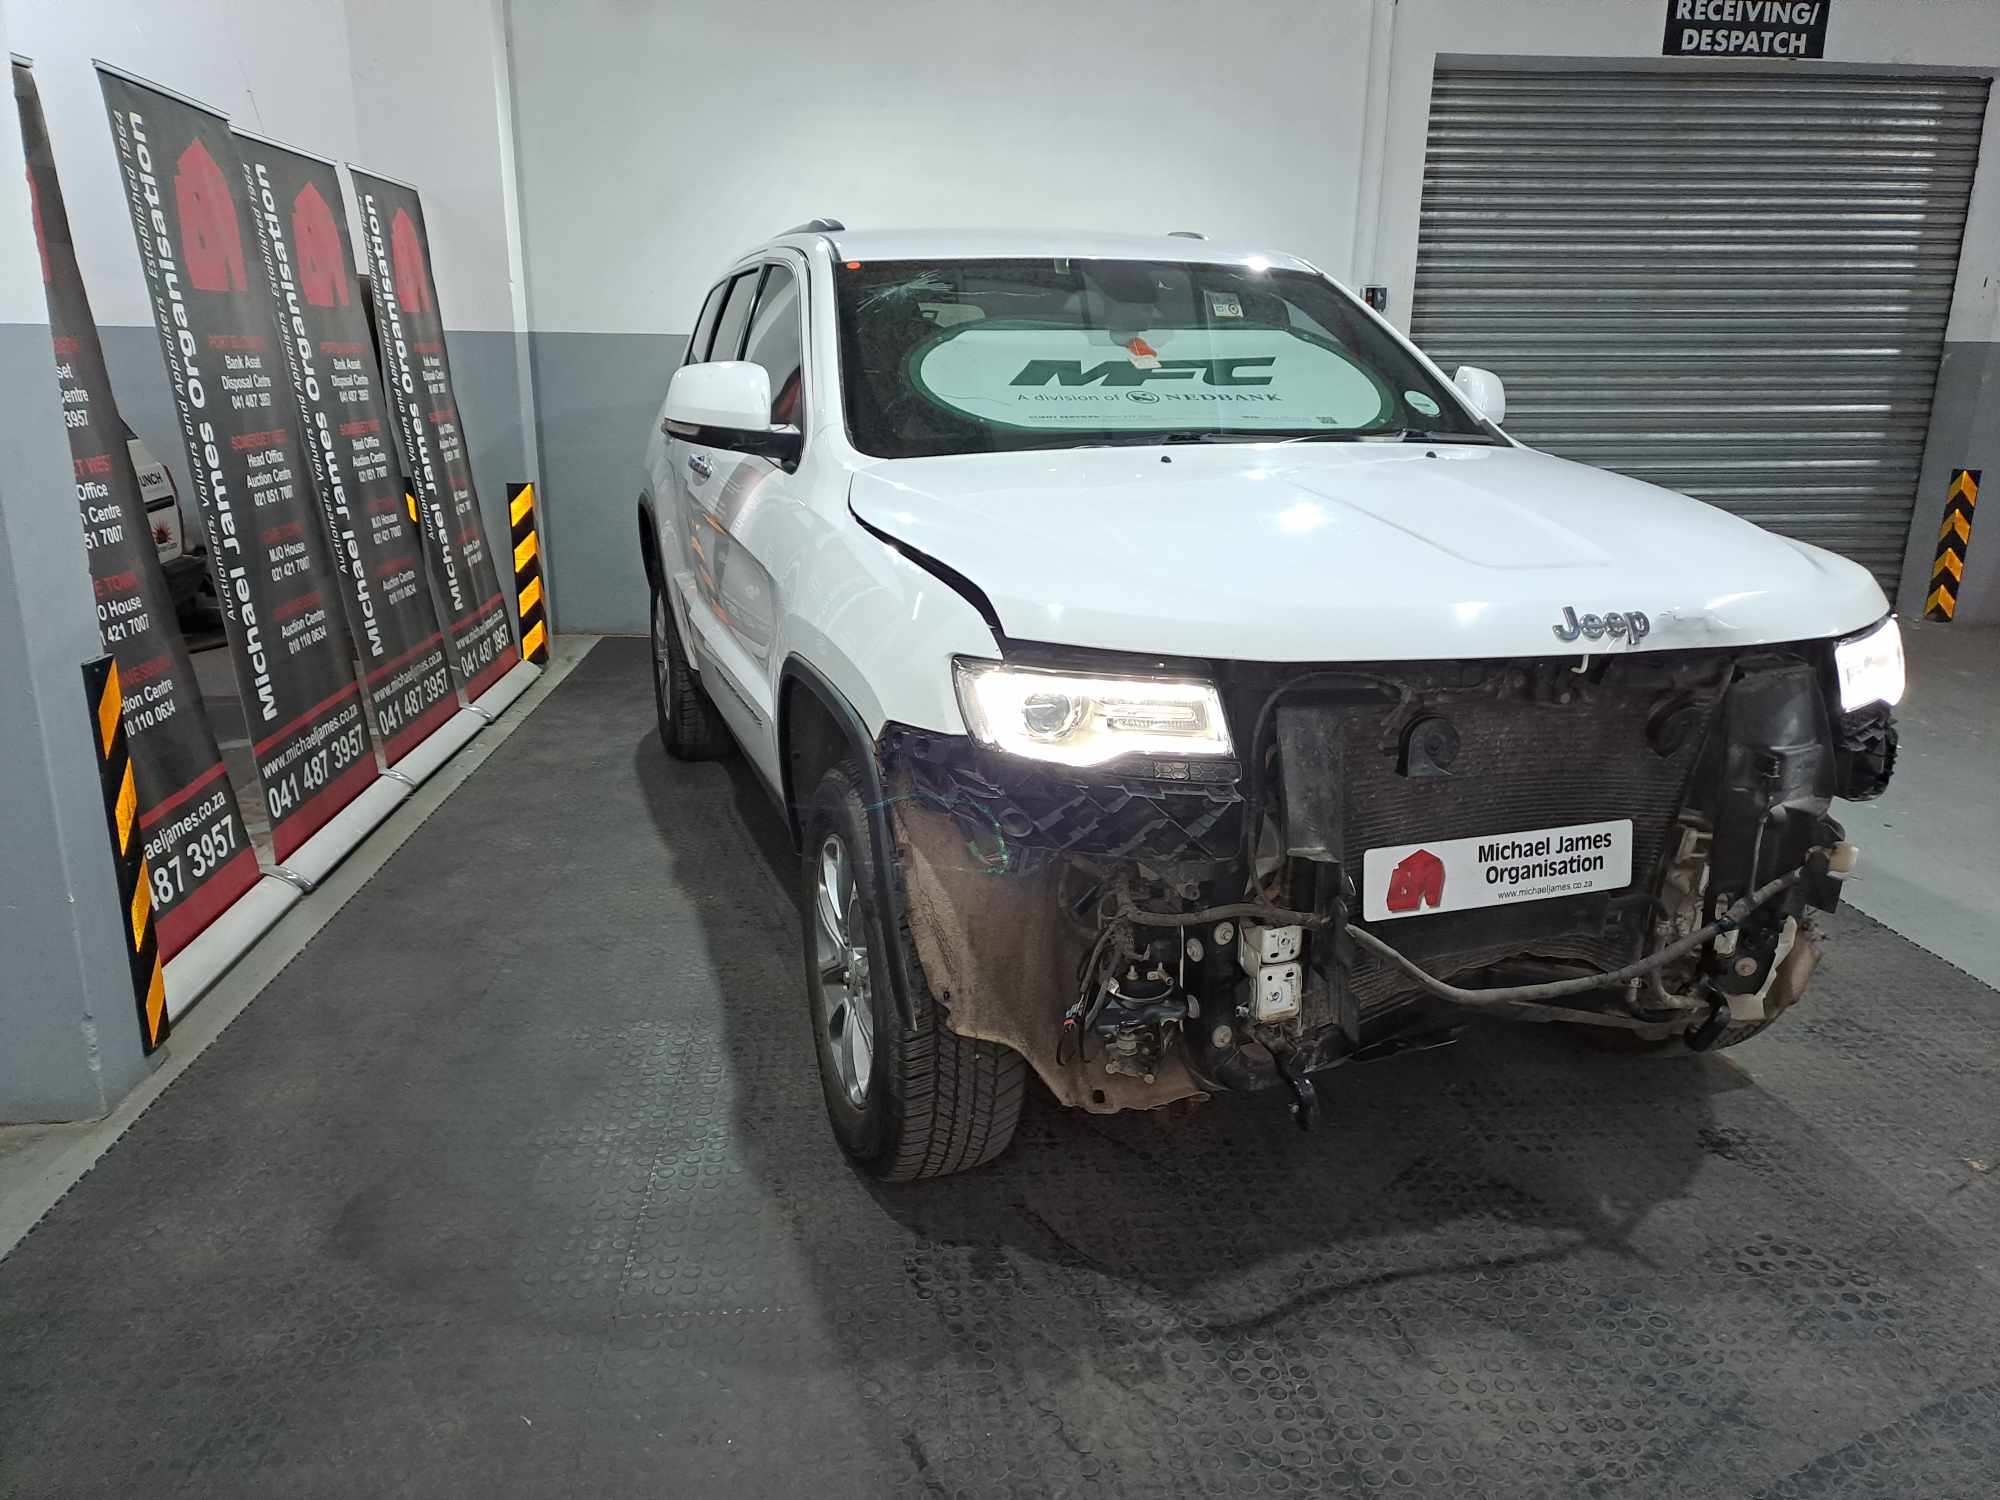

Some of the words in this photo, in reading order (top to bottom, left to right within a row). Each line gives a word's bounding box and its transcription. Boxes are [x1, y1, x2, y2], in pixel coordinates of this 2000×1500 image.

[1676, 0, 1820, 26] RECEIVING/
[1680, 28, 1808, 55] DESPATCH
[113, 110, 133, 159] 1964
[125, 165, 158, 278] Established
[129, 111, 206, 409] Organisation
[255, 163, 320, 401] Organisation
[365, 194, 414, 394] Organisation
[156, 296, 186, 396] Appraisers
[1009, 356, 1276, 387] MFC
[63, 387, 89, 404] entre
[296, 394, 312, 424] and
[1017, 393, 1029, 402] A
[1033, 391, 1106, 402] division
[1107, 391, 1121, 402] of
[1164, 392, 1283, 402] NEDBANK
[64, 409, 89, 428] 3957
[178, 399, 194, 436] and
[306, 427, 325, 480] Valuers
[315, 411, 351, 520] James
[409, 403, 438, 496] James
[76, 481, 109, 501] Office
[190, 441, 211, 507] Valuers
[199, 421, 241, 555] James
[88, 504, 122, 523] Centre
[84, 531, 99, 550] 51
[99, 525, 124, 546] 7007
[430, 503, 464, 611] Michael
[107, 596, 143, 618] House
[341, 530, 384, 657] Michael
[107, 622, 127, 642] 421
[127, 612, 150, 636] 7007
[229, 566, 279, 721] Michael
[1552, 606, 1650, 645] Jeep
[461, 648, 480, 677] 041
[144, 679, 174, 702] Centre
[379, 700, 404, 736] 041
[404, 686, 424, 717] 487
[424, 667, 449, 702] 3957
[123, 720, 136, 738] 10
[135, 710, 154, 731] 110
[154, 698, 176, 722] 0634
[268, 772, 300, 818] 041
[303, 751, 329, 790] 487
[334, 723, 365, 769] 3957
[186, 814, 237, 877] 3957
[1478, 837, 1550, 863] Michael
[1555, 832, 1612, 854] James
[1485, 855, 1604, 884] Organisation
[1497, 879, 1593, 899] www.michaeljames.co.za
